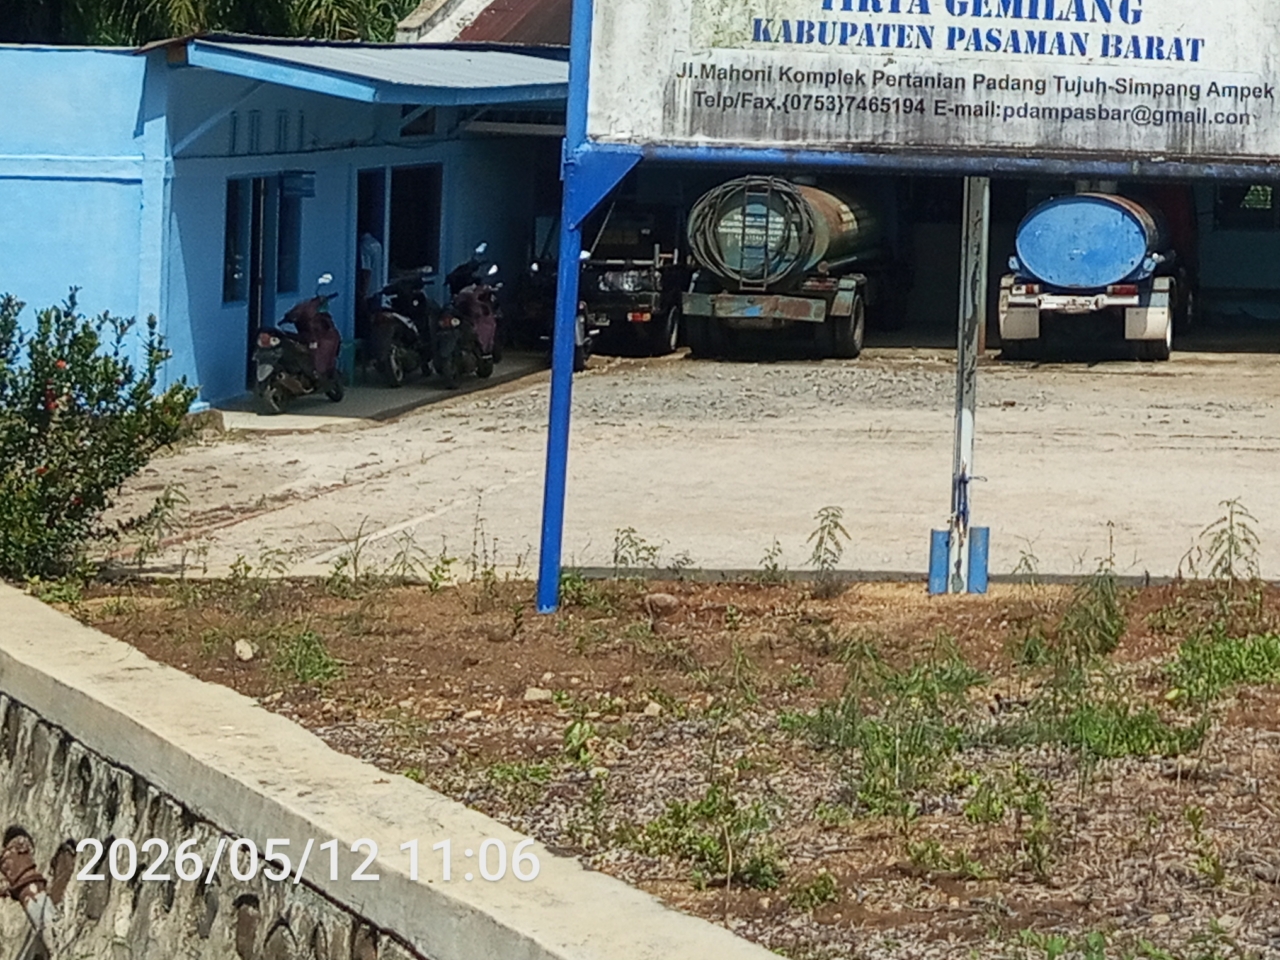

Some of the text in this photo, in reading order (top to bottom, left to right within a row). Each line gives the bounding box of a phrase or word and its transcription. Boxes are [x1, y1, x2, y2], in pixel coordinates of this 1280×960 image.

[751, 18, 1205, 62] KABUPATEN PASAMAN BARAT
[676, 62, 1275, 104] Jl.Mahoni Komplek Pertanian Padang Tujuh-Simpang Ampek
